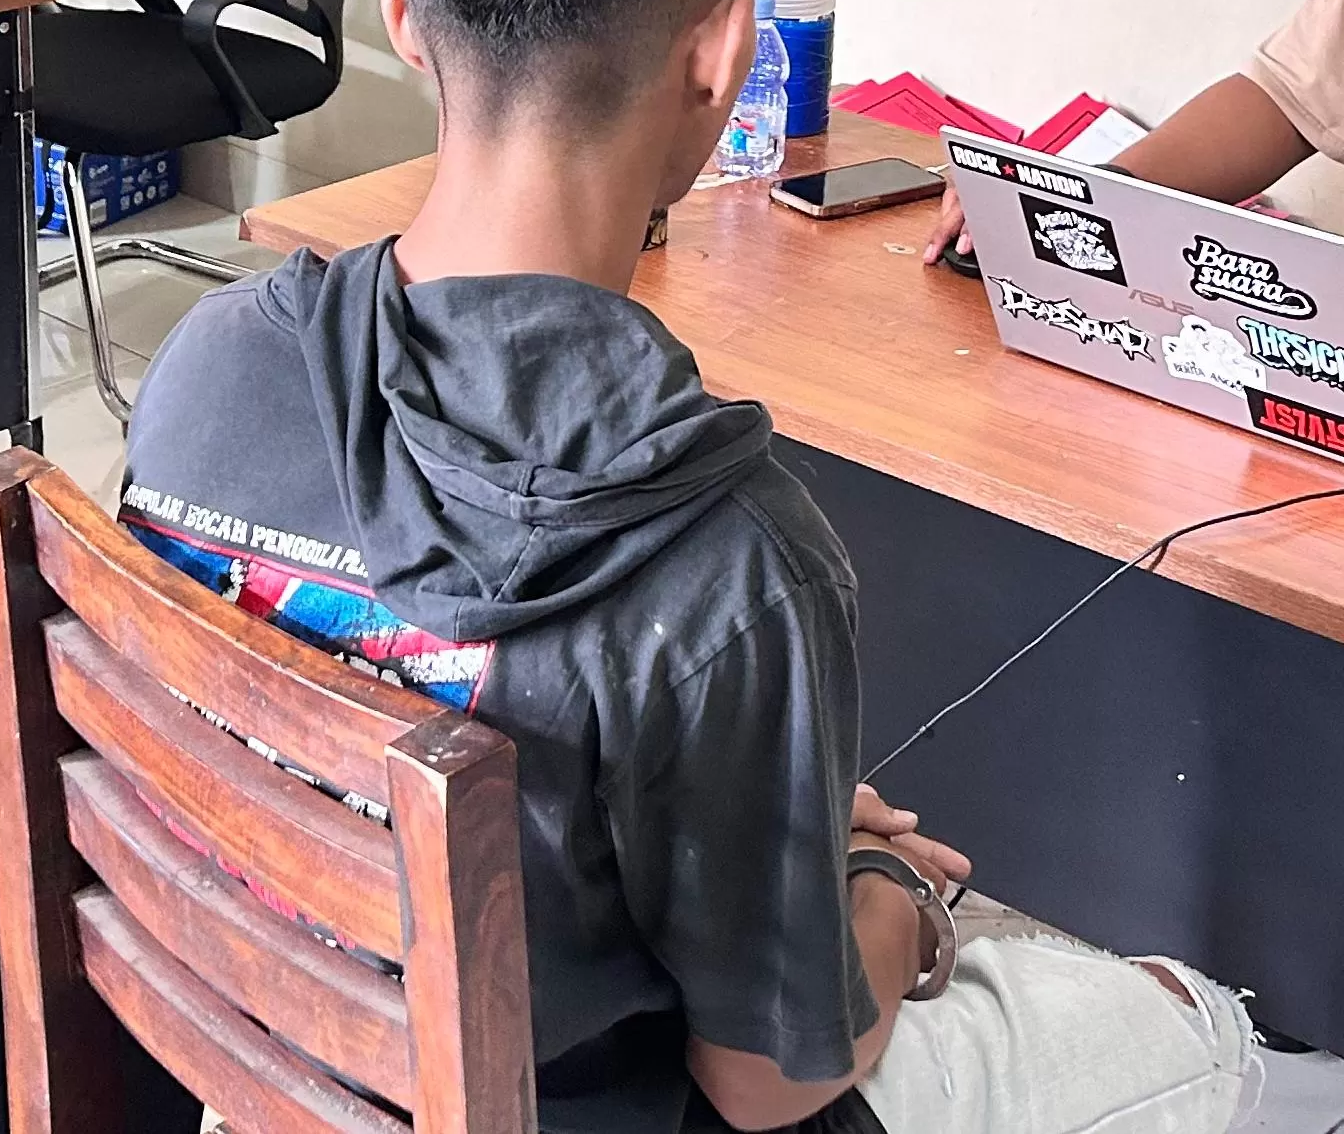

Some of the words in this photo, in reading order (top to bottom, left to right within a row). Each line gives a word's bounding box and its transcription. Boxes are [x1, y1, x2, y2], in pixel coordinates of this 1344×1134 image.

[952, 146, 1002, 176] ROCK
[1016, 164, 1086, 199] NATION
[1188, 239, 1273, 281] Bara
[1129, 288, 1197, 318] ASUS
[1197, 267, 1300, 308] suara
[182, 503, 249, 544] BOCAH
